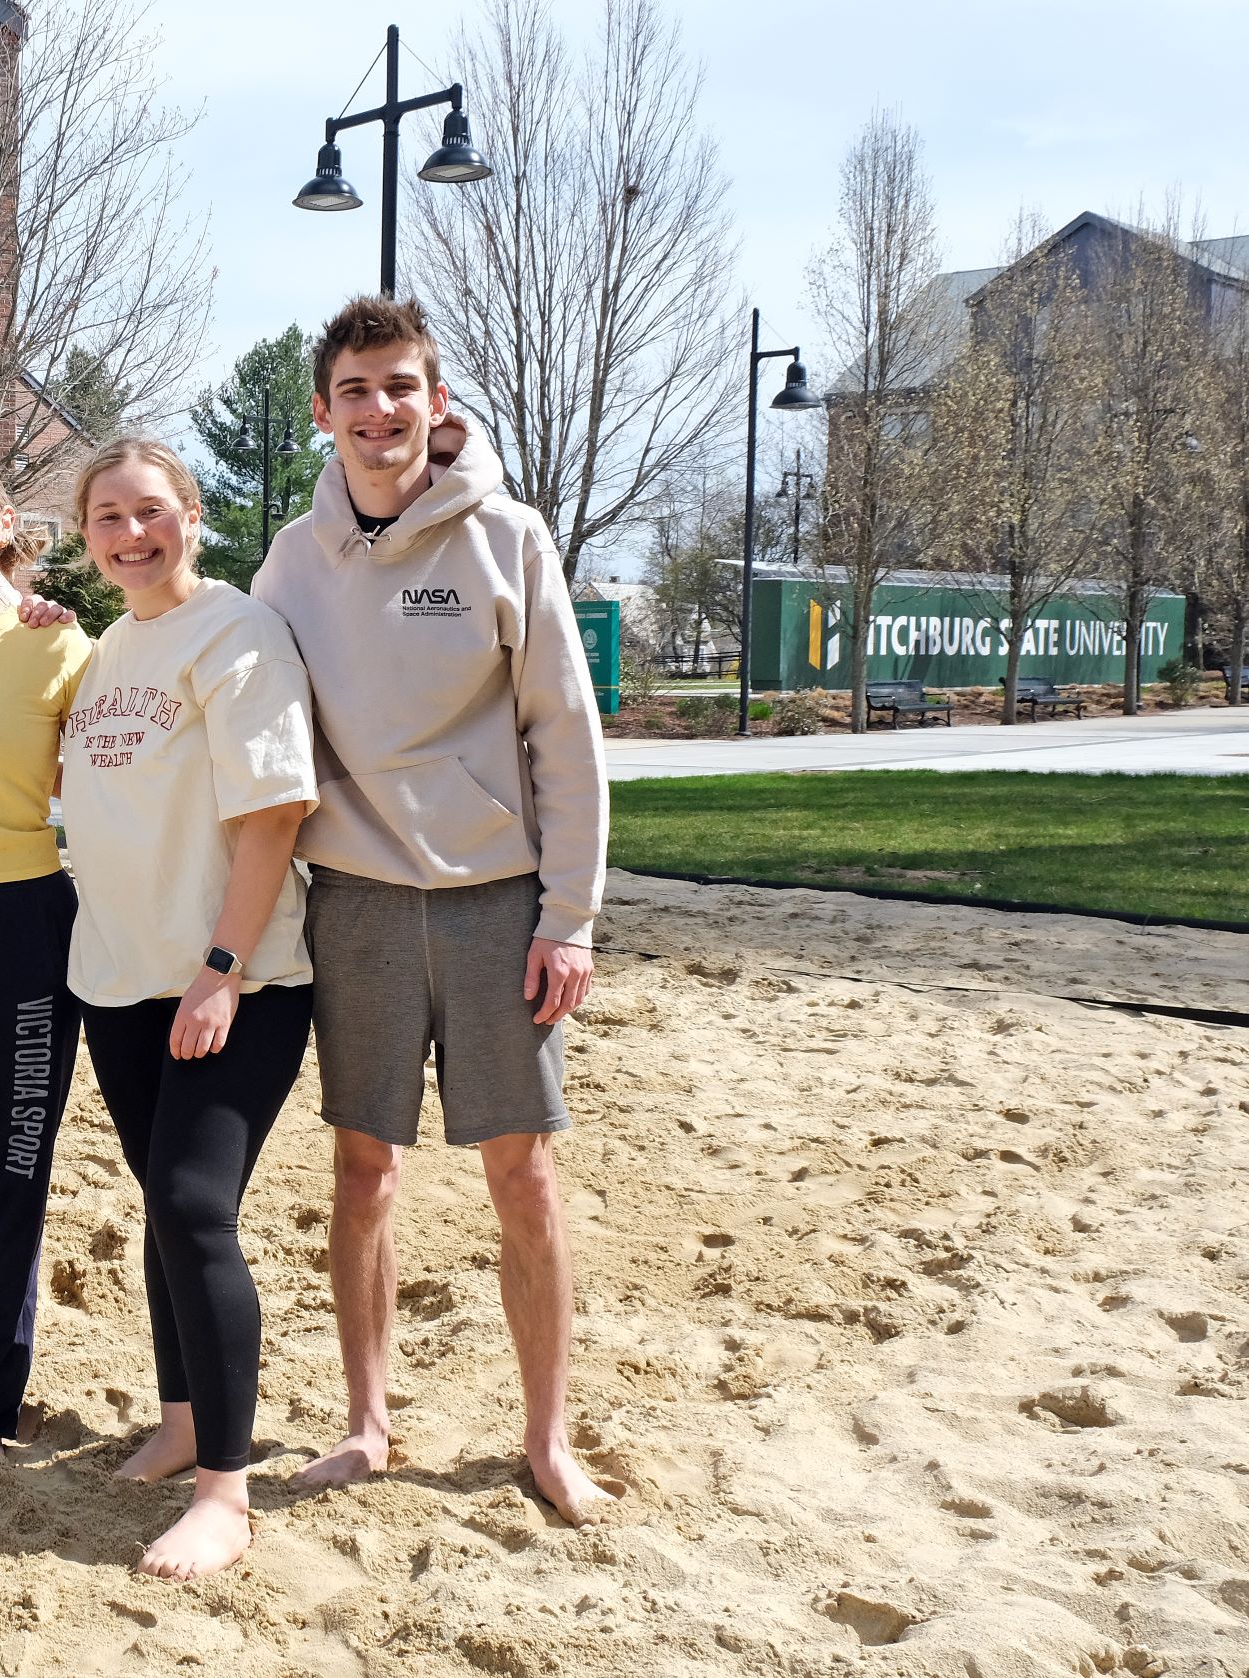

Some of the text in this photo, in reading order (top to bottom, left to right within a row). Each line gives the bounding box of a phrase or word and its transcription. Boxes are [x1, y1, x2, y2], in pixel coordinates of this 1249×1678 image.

[401, 588, 460, 605] NASA
[866, 615, 1169, 656] ITCHBURG SATE UNIVEITY
[69, 687, 182, 738] HEALTH
[83, 731, 145, 749] IS THE NEW
[89, 751, 133, 768] WEALTH
[4, 995, 54, 1180] VICTORIA SPORT
